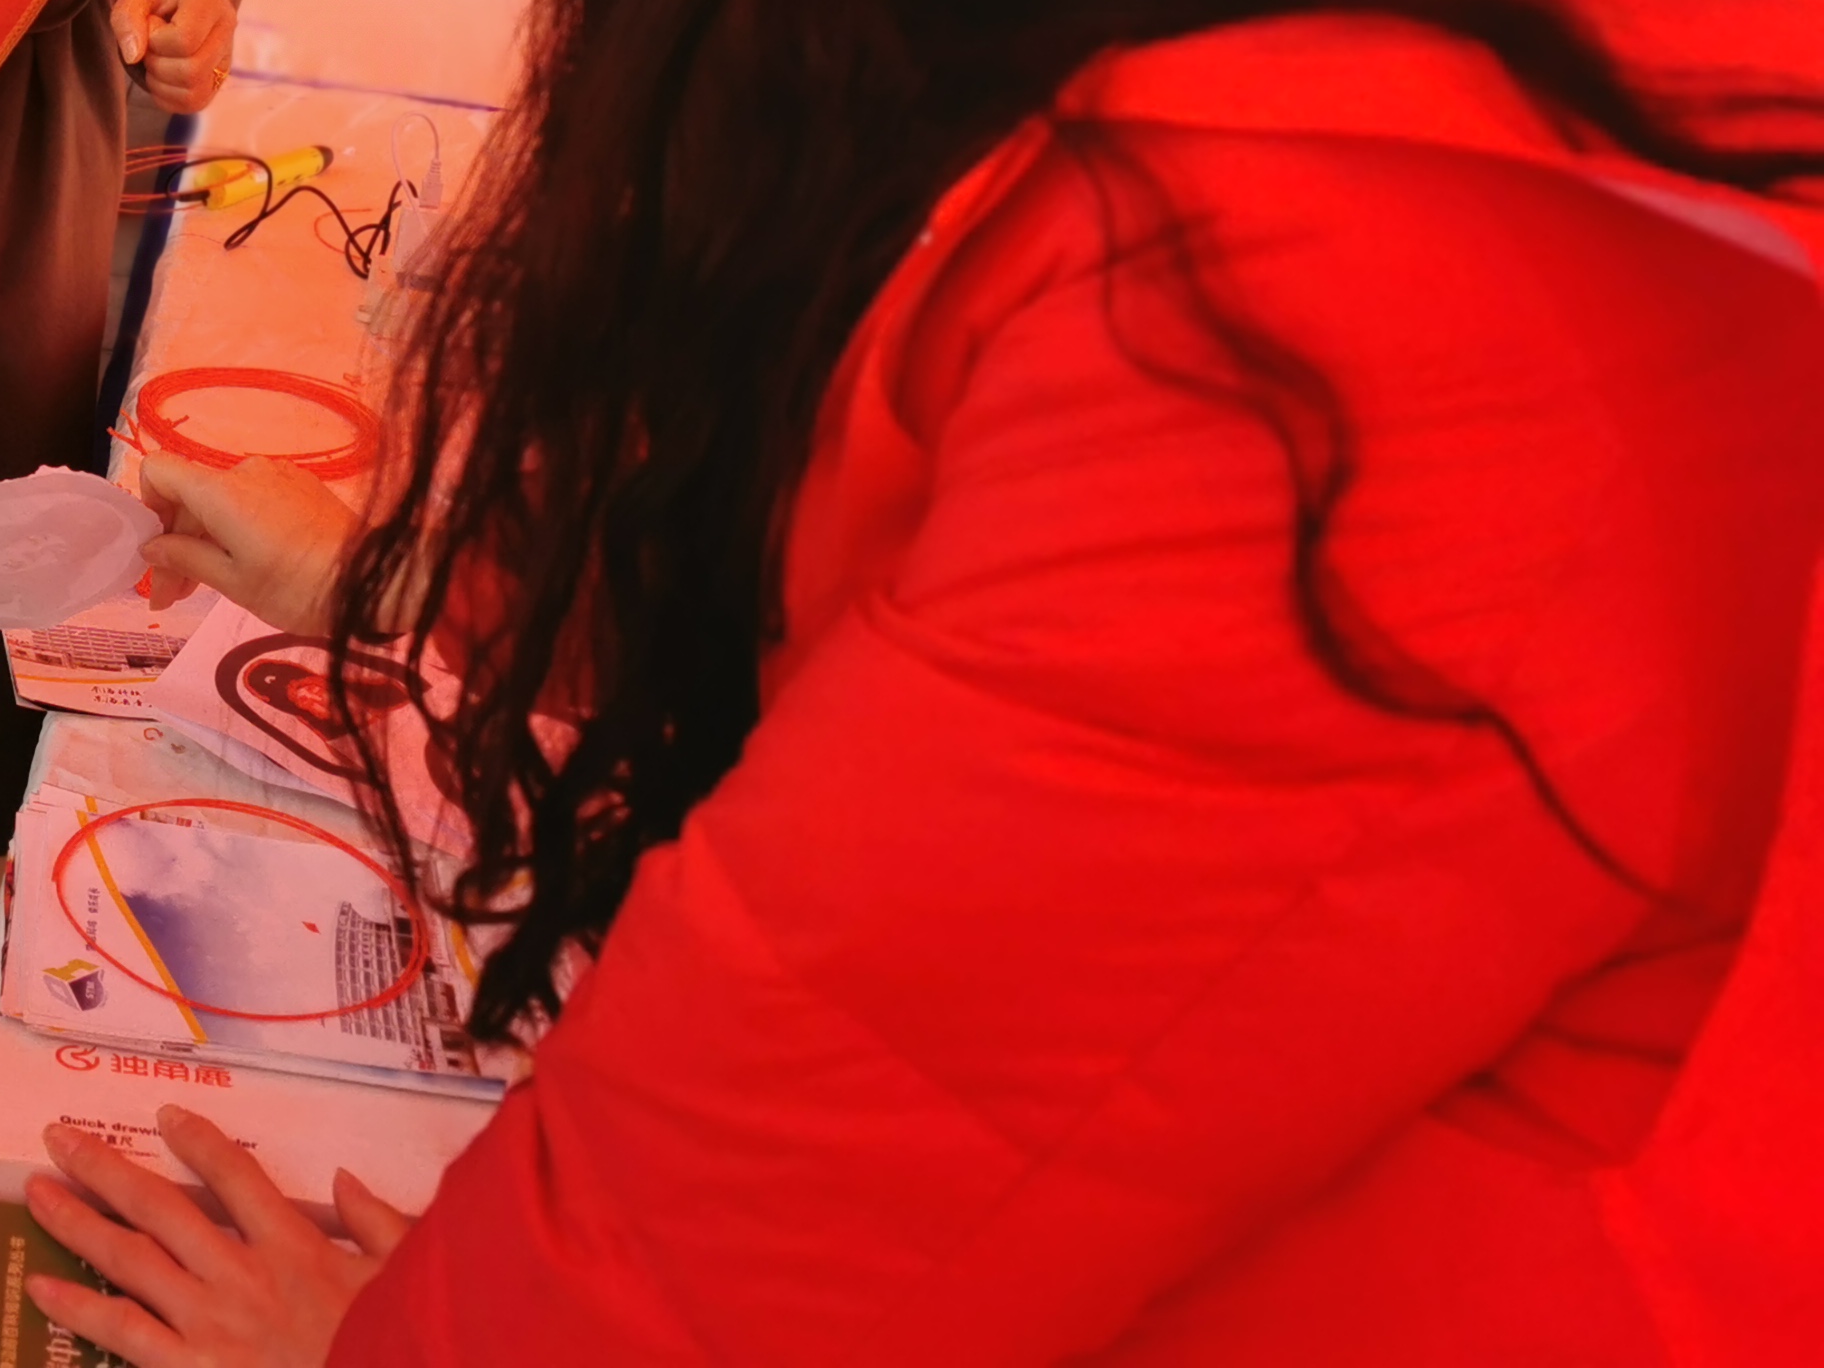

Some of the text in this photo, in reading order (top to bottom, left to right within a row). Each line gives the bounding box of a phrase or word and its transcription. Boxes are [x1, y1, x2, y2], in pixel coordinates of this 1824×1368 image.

[110, 1053, 233, 1088] 独角鹿
[59, 1114, 106, 1131] Quick
